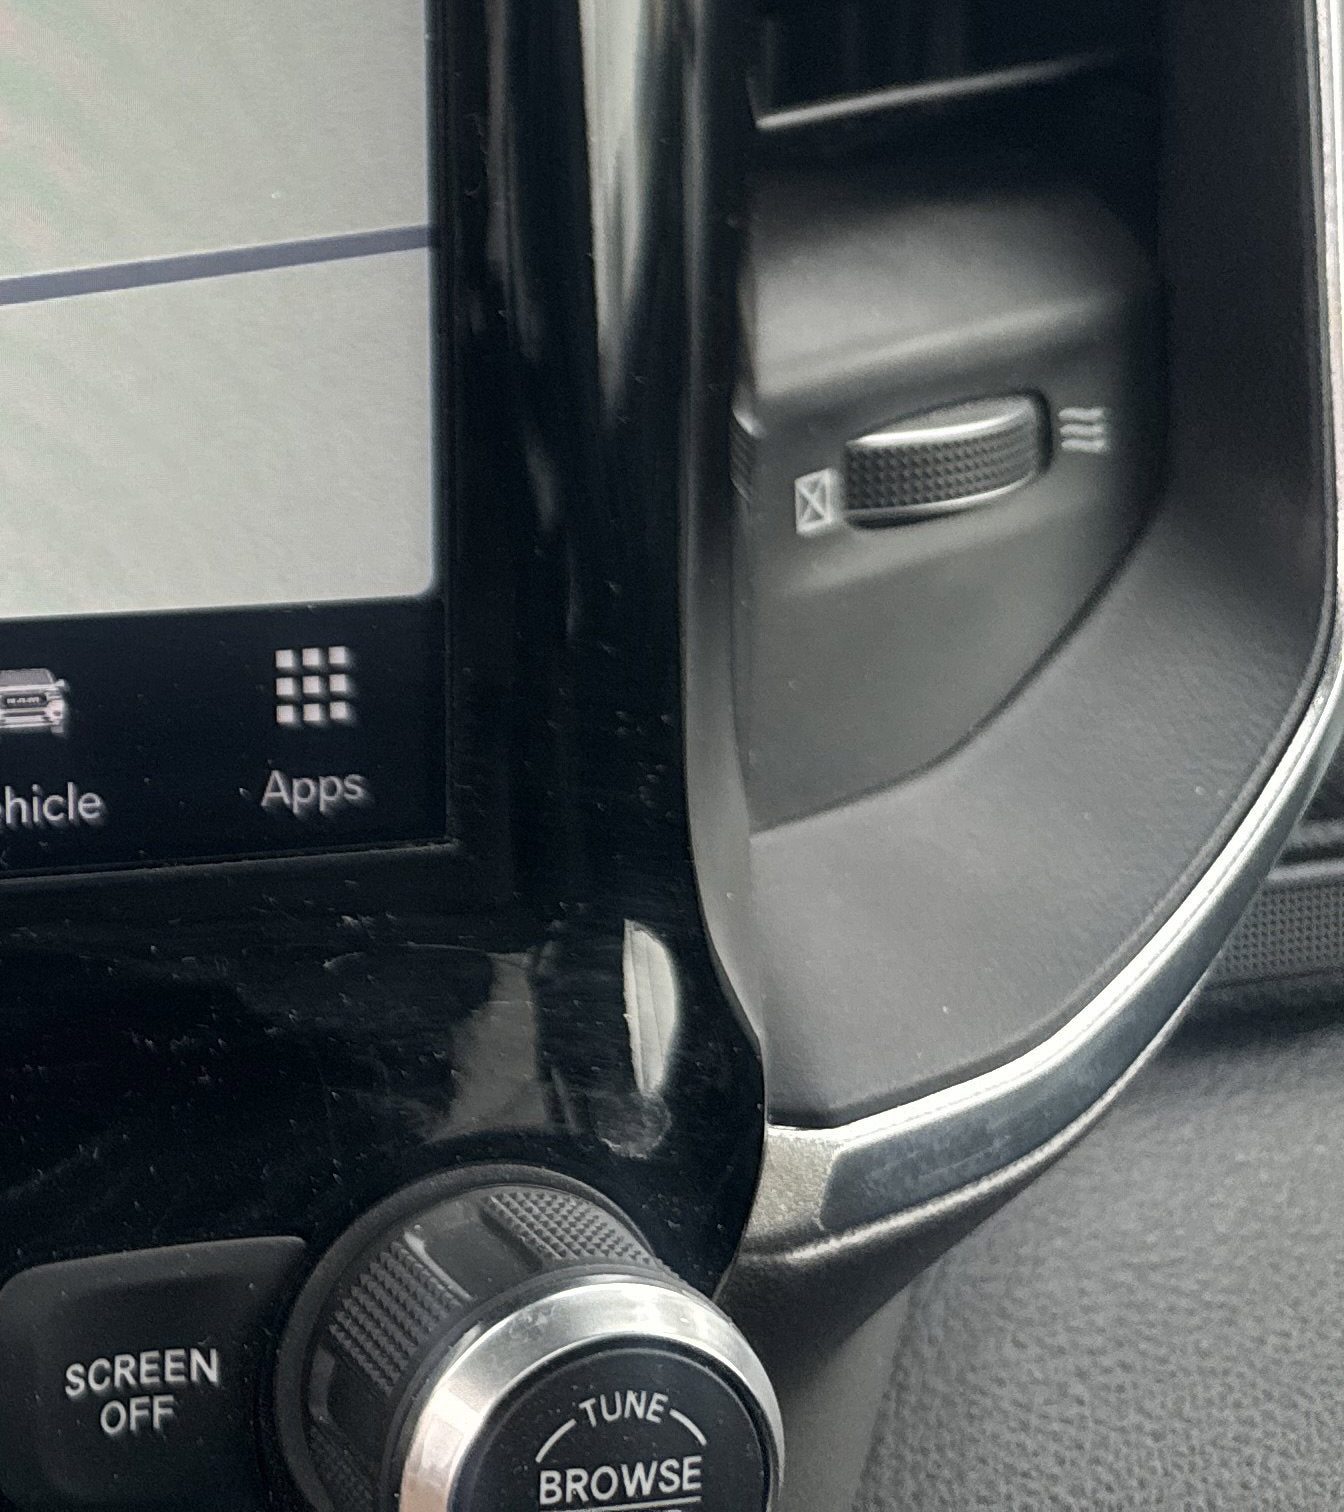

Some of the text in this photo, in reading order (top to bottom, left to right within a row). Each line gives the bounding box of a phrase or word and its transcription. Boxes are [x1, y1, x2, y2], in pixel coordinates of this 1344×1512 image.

[260, 768, 367, 818] Apps
[64, 1348, 220, 1397] SCREEN
[100, 1394, 176, 1435] OFF
[578, 1390, 670, 1428] TUNE
[539, 1455, 704, 1506] BROWSE
